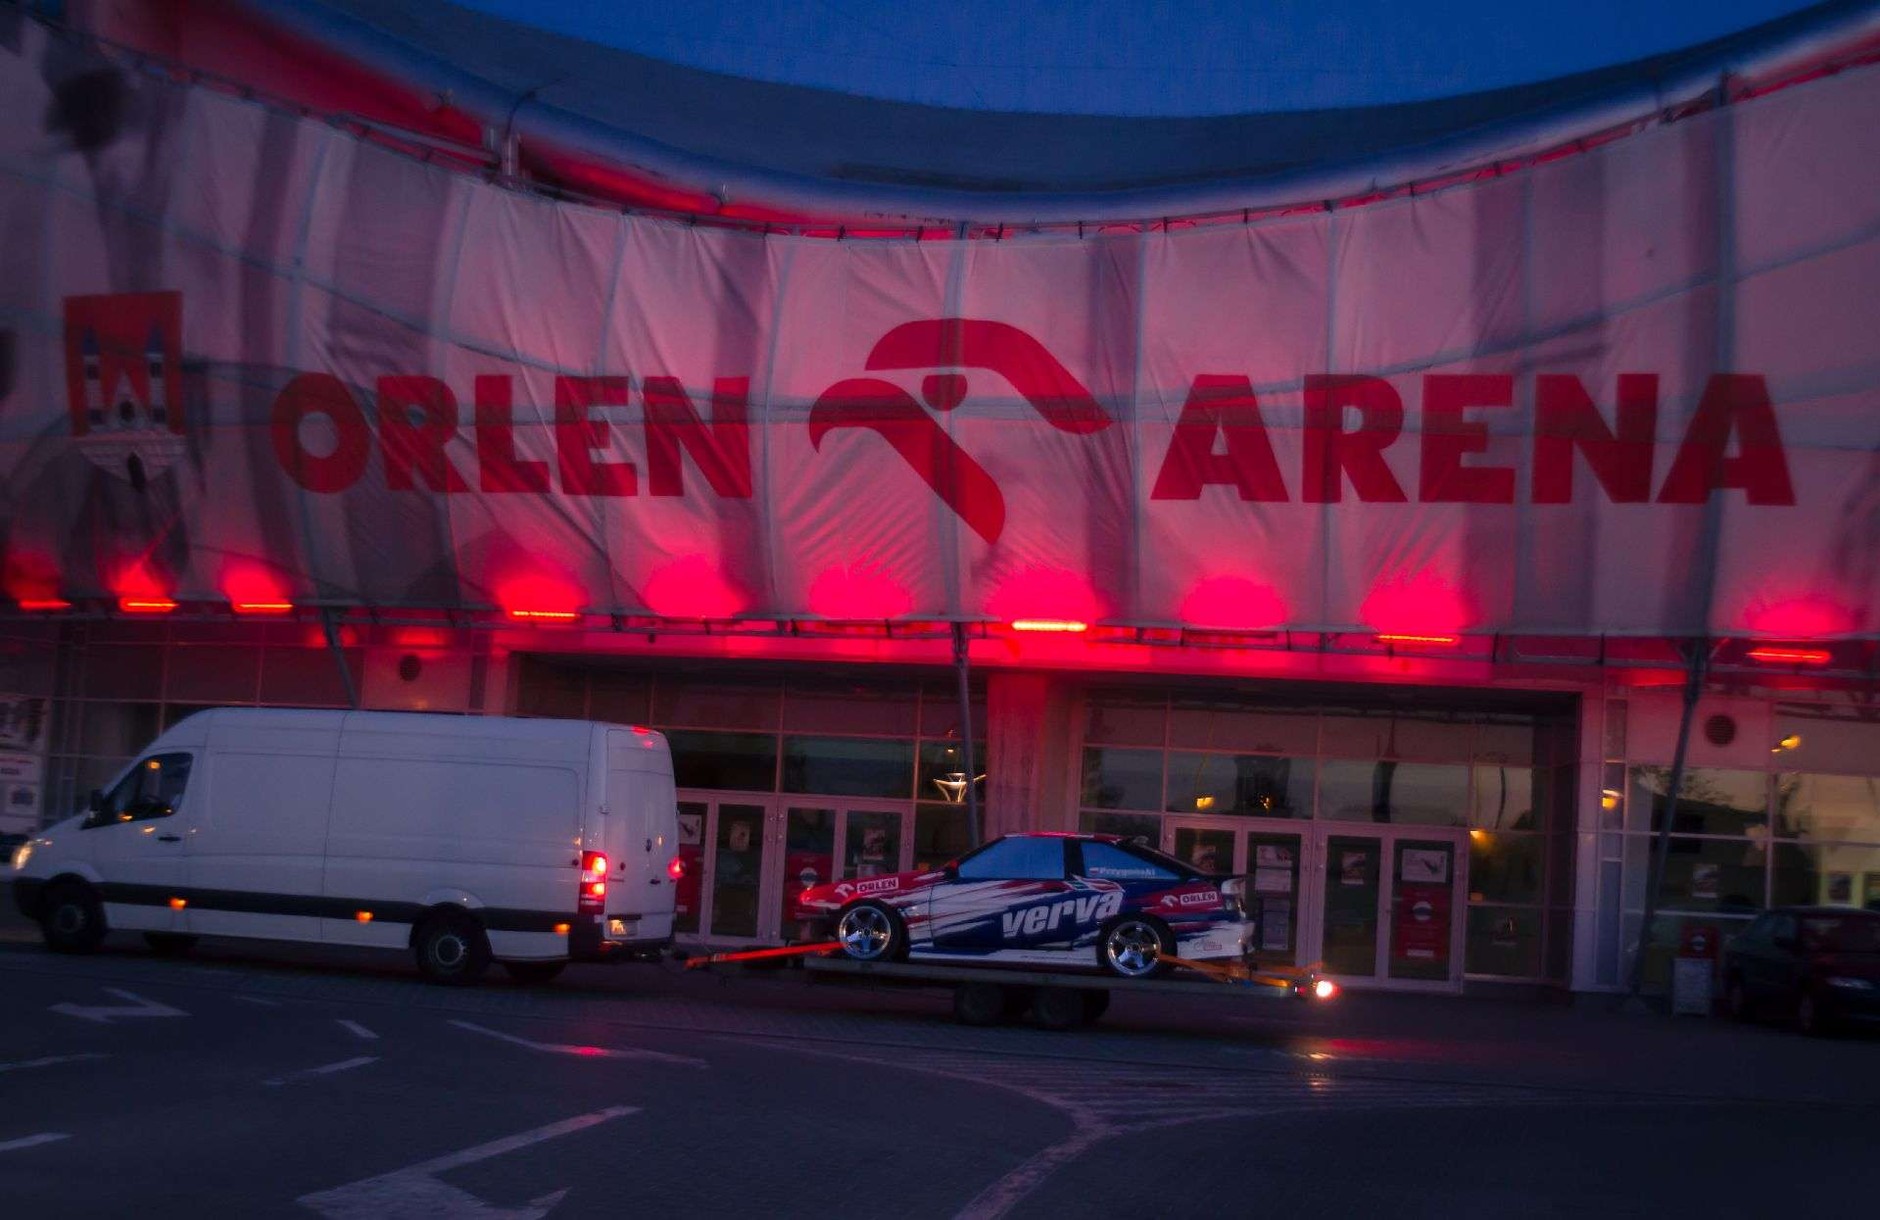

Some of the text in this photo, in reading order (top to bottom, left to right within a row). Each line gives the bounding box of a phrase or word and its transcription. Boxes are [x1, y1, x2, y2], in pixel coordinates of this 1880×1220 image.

[272, 372, 1797, 506] ORLEN ARENA
[859, 879, 897, 892] ORLEN
[1003, 891, 1124, 938] verva
